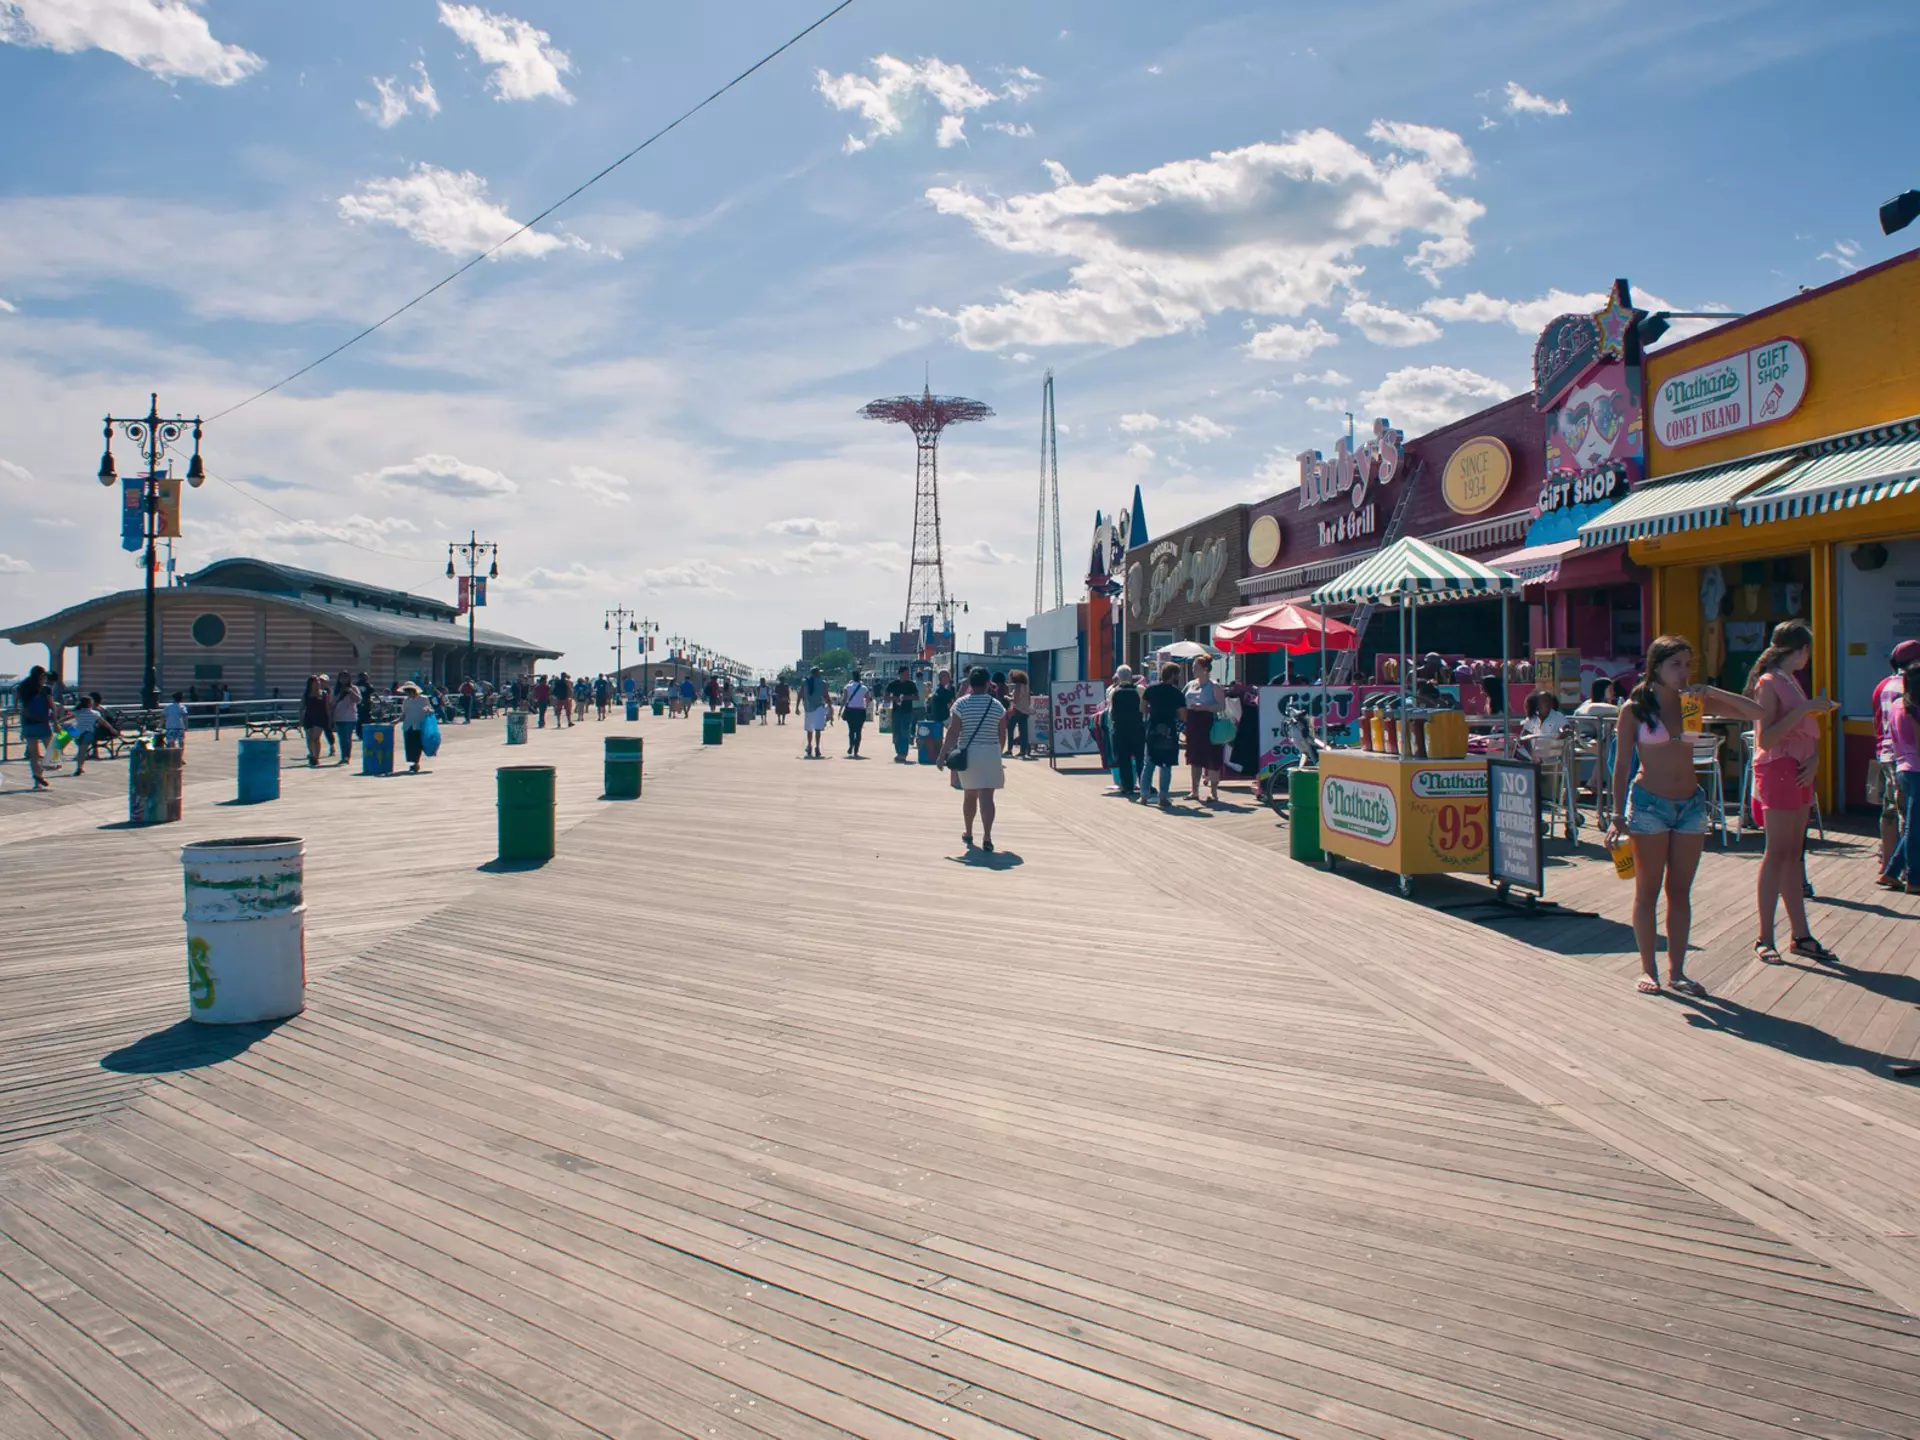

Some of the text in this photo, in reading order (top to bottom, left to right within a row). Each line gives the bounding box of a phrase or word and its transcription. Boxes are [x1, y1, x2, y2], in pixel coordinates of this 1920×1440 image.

[1757, 344, 1789, 369] GIFT
[1665, 366, 1739, 405] Nathan's
[1757, 363, 1789, 385] SHOP
[1666, 402, 1741, 442] CONEY ISLAND
[1296, 417, 1402, 511] Ruby's
[1460, 451, 1489, 479] SINCE
[1464, 475, 1487, 501] 1934
[1574, 470, 1616, 504] SHOP
[1318, 503, 1375, 547] Bar & Grill
[1055, 703, 1098, 717] ICE
[1054, 717, 1091, 731] CREA
[1500, 771, 1528, 795] NO
[1327, 780, 1391, 826] Nathan's
[1438, 804, 1484, 851] 95
[1499, 831, 1534, 849] Beyond
[1507, 847, 1528, 862] This
[1503, 859, 1530, 877] Point
